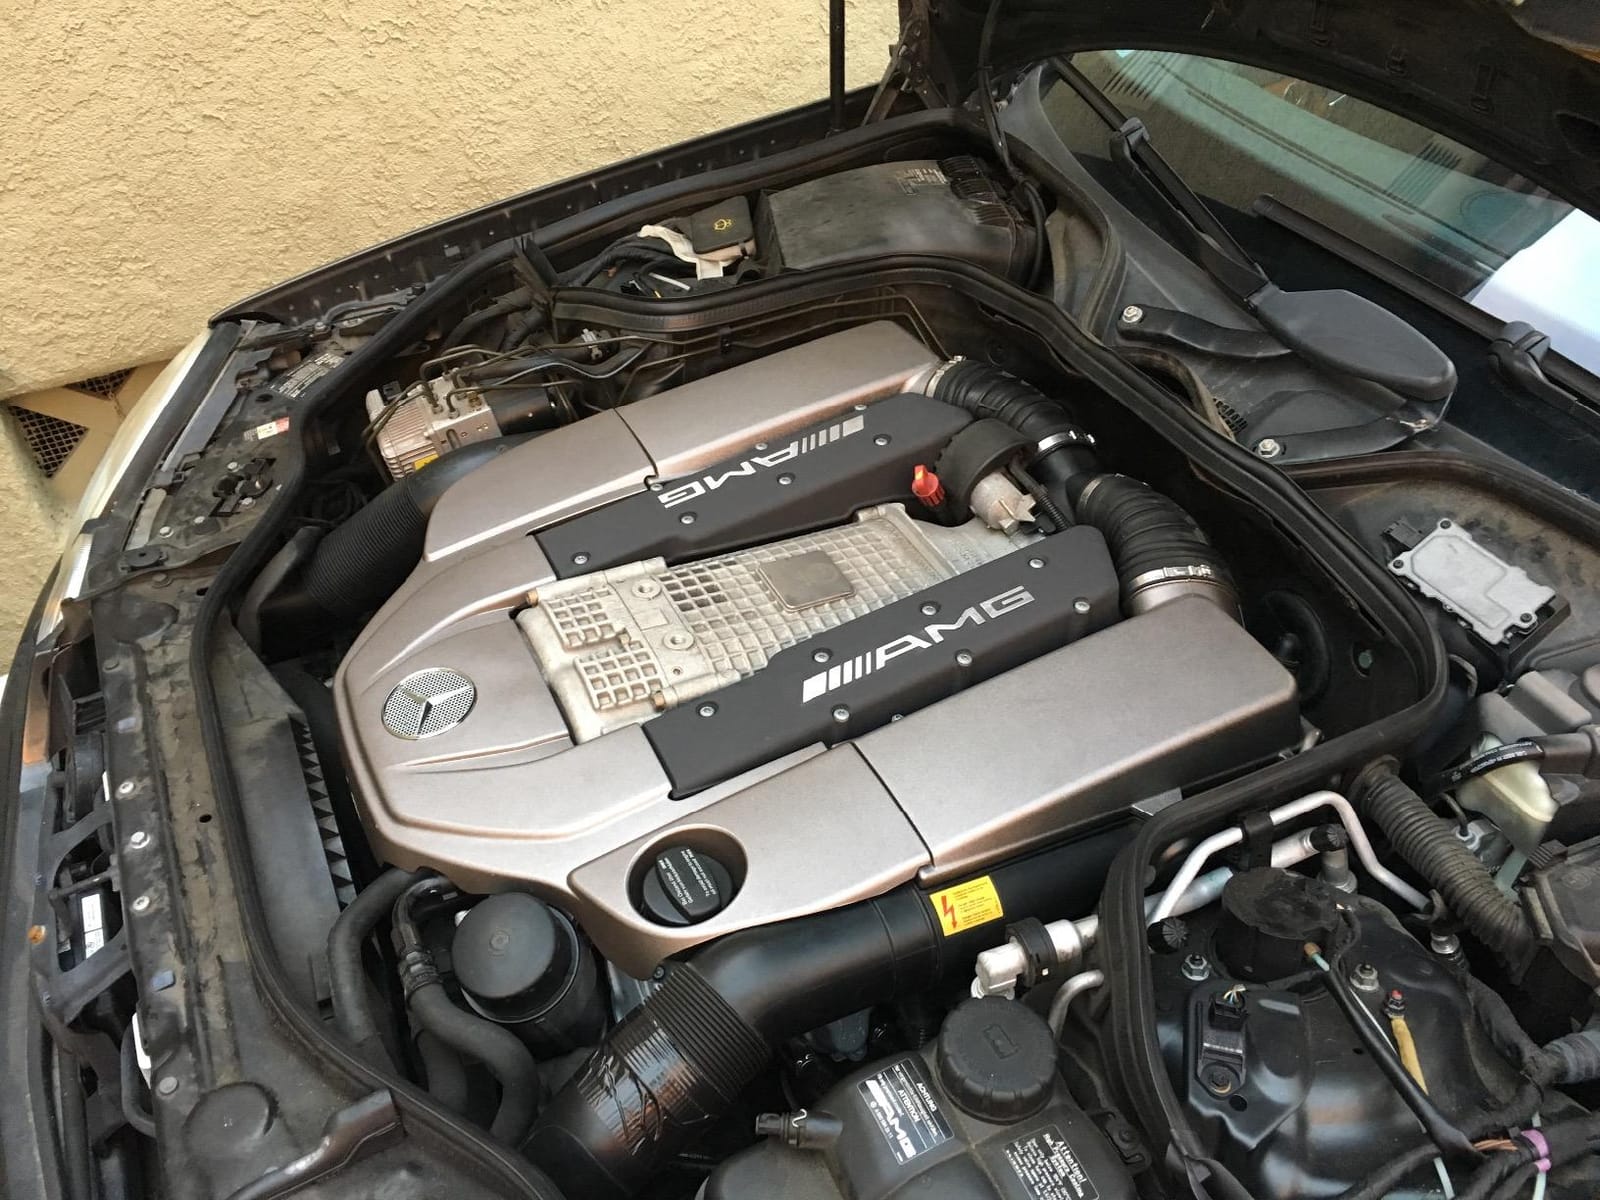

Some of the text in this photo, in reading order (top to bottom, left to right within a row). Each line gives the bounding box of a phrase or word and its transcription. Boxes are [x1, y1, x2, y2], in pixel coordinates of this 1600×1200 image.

[658, 440, 799, 510] AMG
[876, 586, 1035, 670] AMG
[897, 1088, 920, 1122] ATTENTION
[916, 1081, 937, 1111] ACHTUNG
